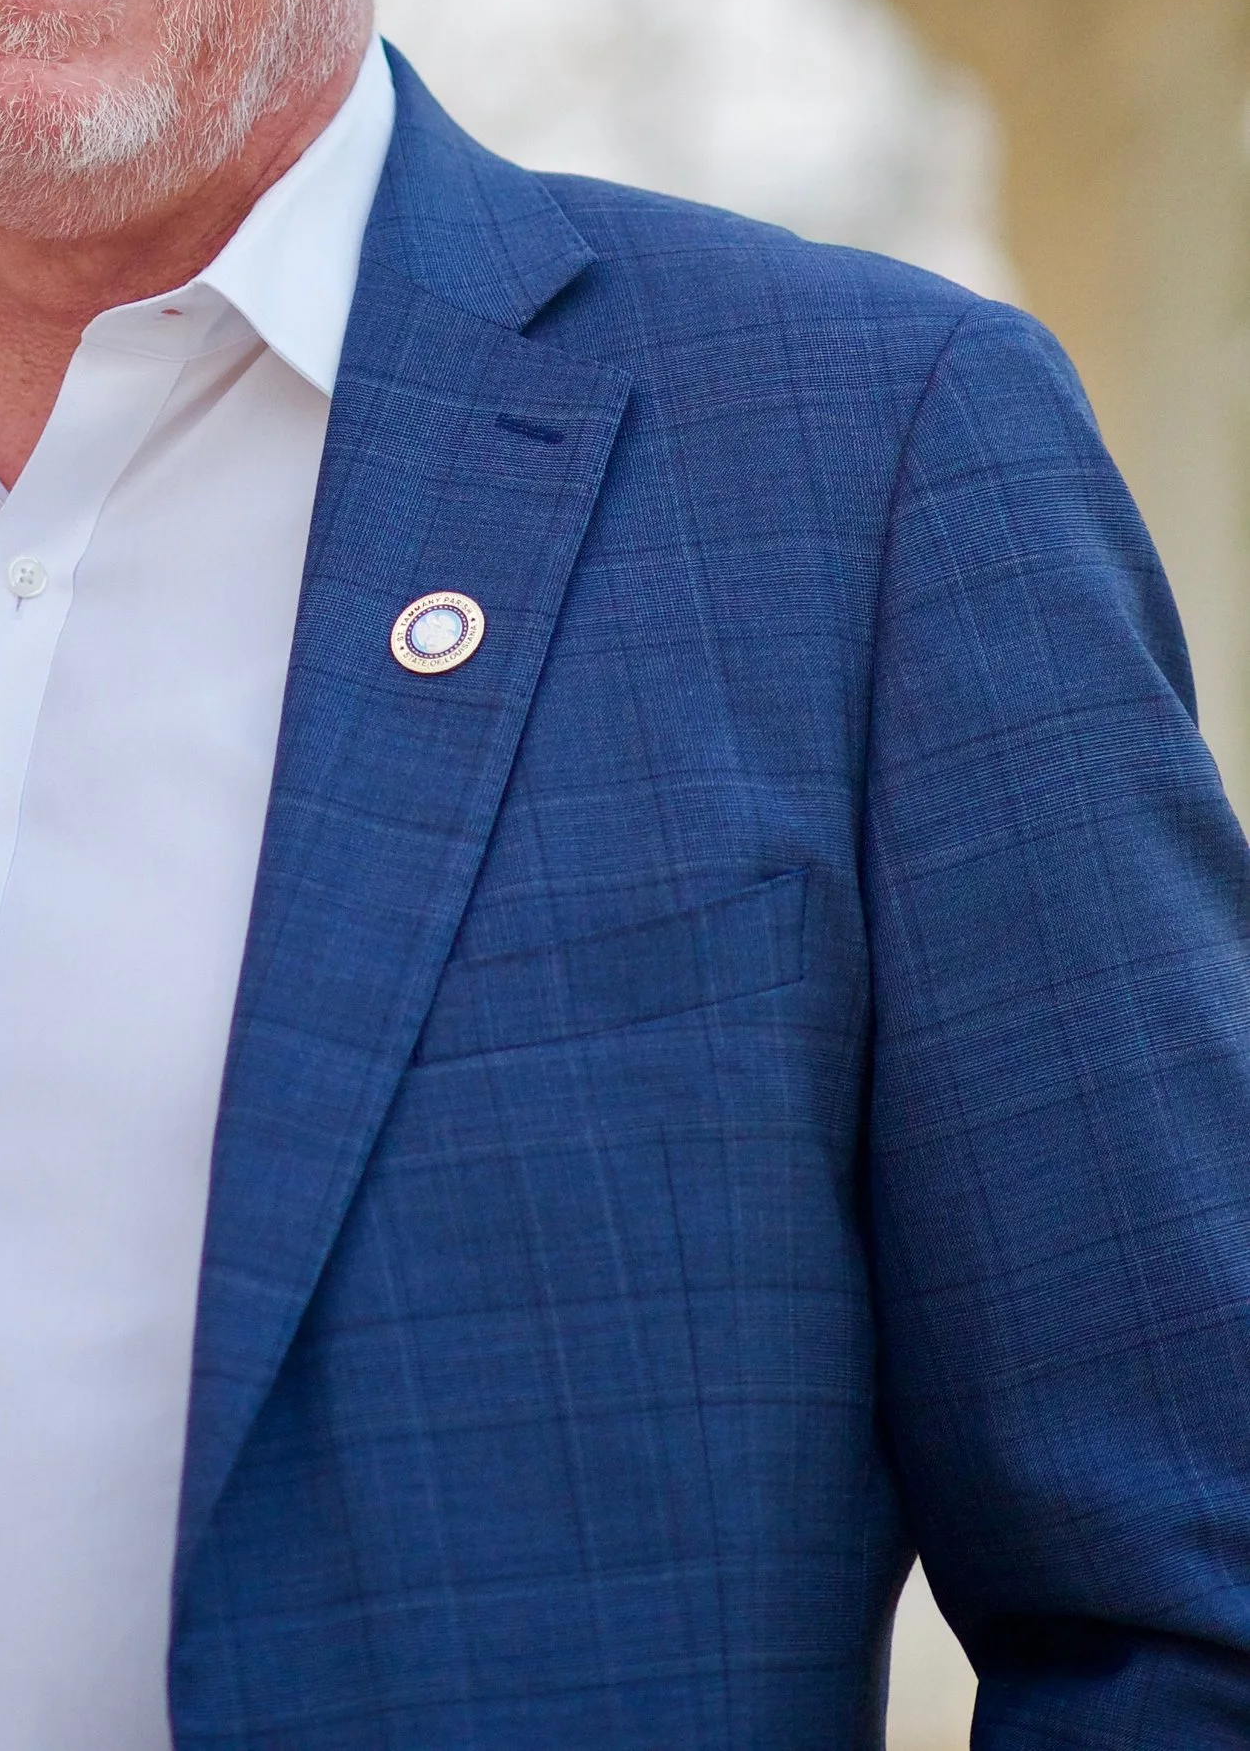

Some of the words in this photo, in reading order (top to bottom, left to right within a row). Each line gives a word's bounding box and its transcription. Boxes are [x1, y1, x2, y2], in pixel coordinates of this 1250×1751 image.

[400, 597, 441, 627] TAMMANY
[443, 596, 473, 614] PARISH
[403, 651, 427, 667] STATE
[430, 659, 442, 667] OF
[444, 624, 478, 663] LOUISIANA
